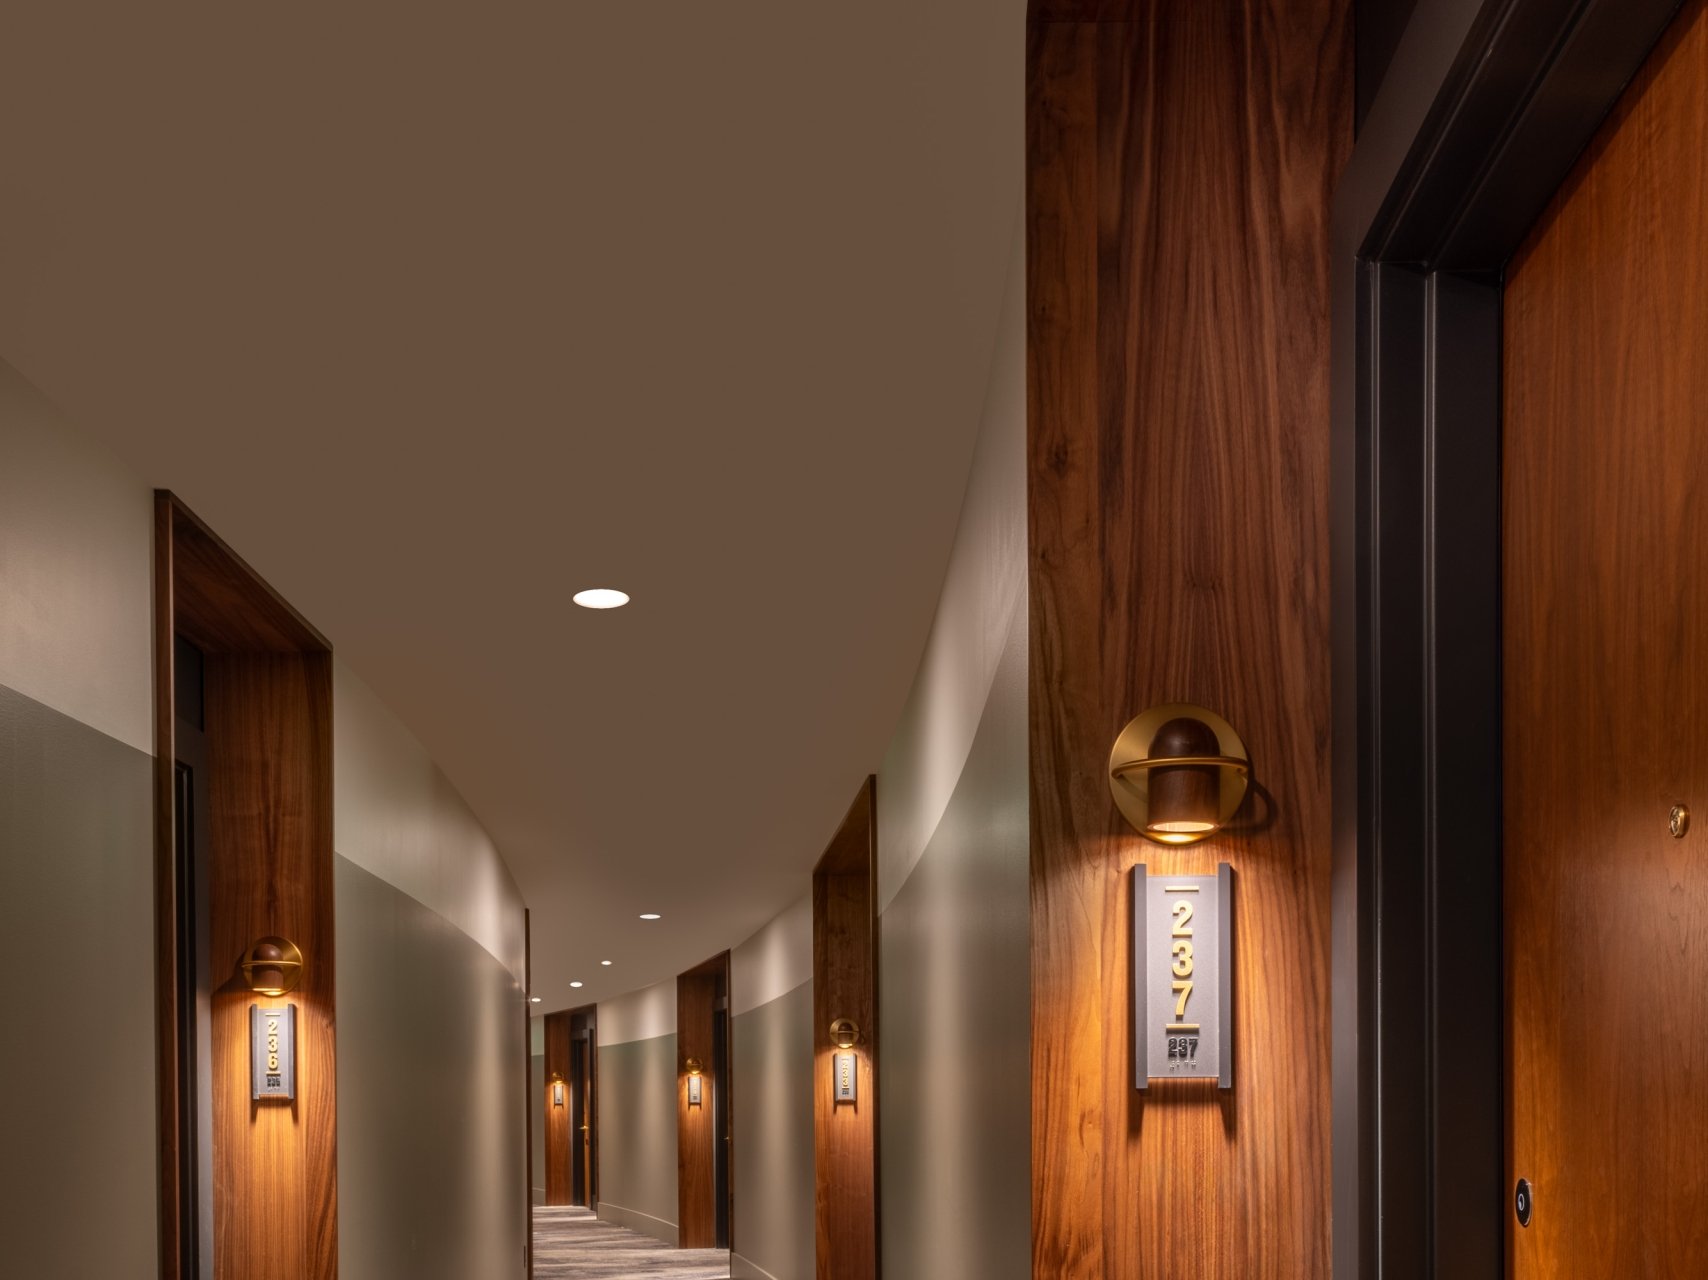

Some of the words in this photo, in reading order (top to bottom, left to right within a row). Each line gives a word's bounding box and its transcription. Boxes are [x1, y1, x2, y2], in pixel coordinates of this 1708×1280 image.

[1172, 900, 1194, 1017] 237
[268, 1019, 278, 1070] 236
[1168, 1038, 1198, 1058] 237
